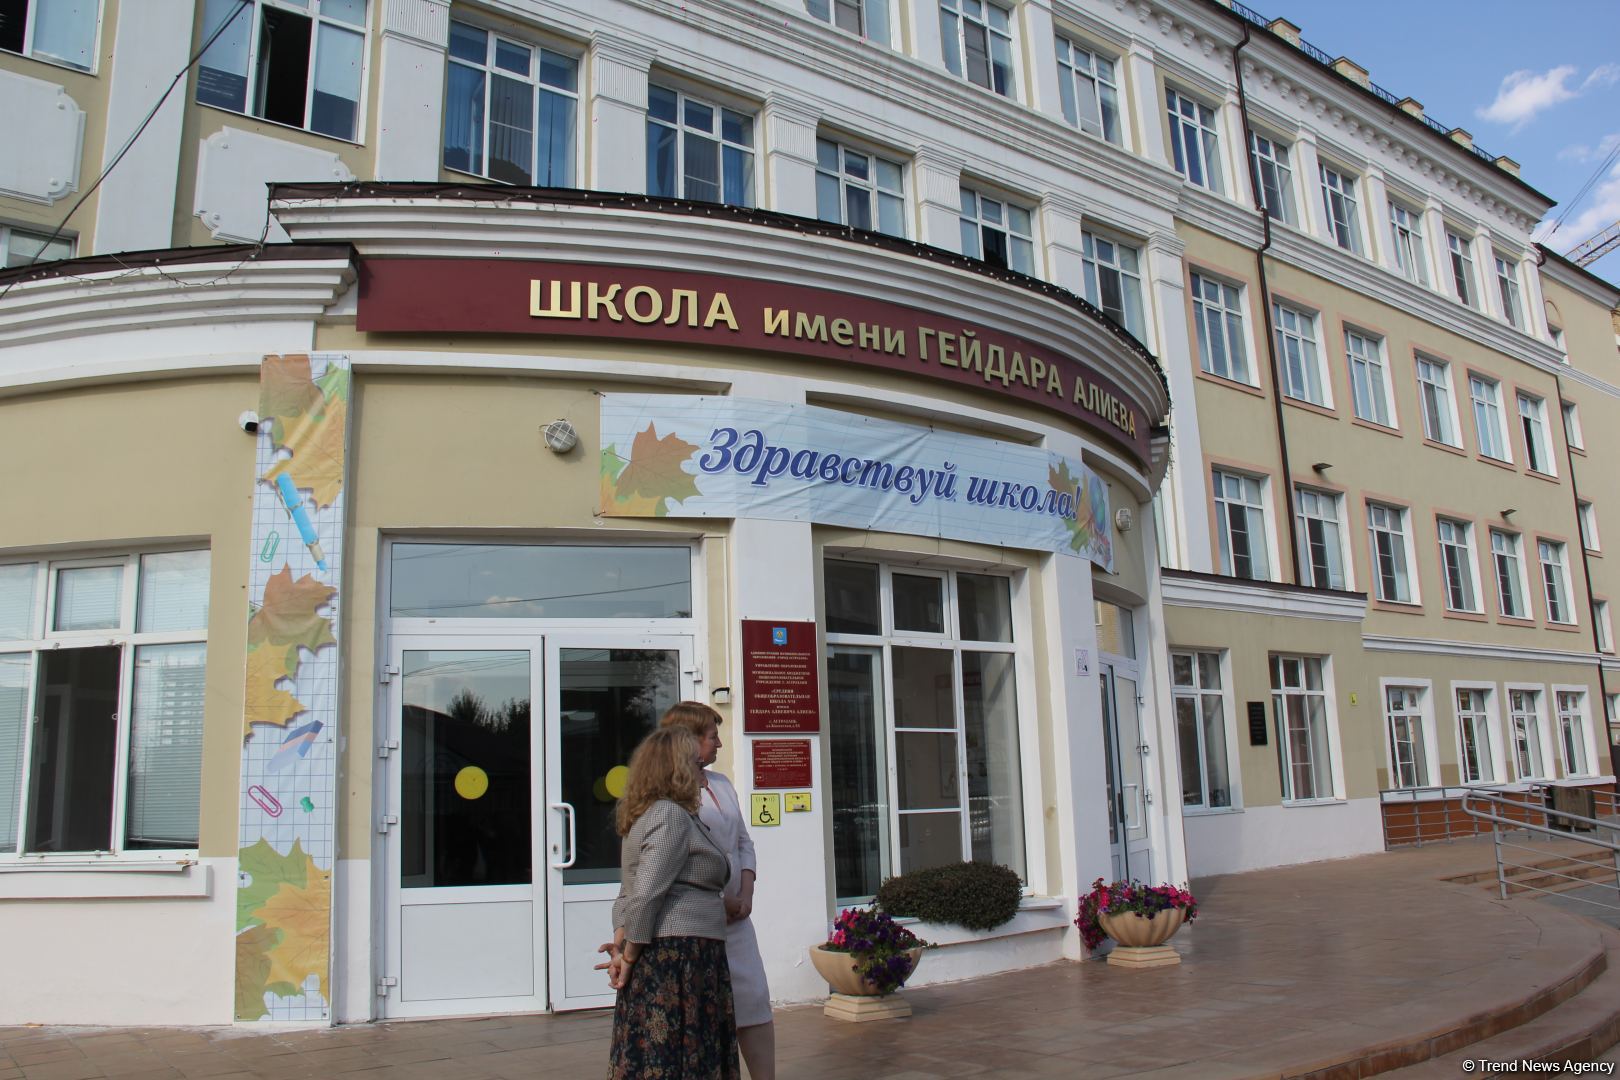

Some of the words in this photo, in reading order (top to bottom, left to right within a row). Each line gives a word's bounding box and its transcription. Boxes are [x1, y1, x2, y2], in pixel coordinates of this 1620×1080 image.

[530, 279, 740, 331] ШКОЛА
[763, 307, 906, 357] имени
[918, 328, 1064, 398] ГЕЙДАРА
[1073, 376, 1137, 440] АЛИЕВА
[699, 427, 956, 504] Здравствуй
[966, 476, 1082, 519] школа!
